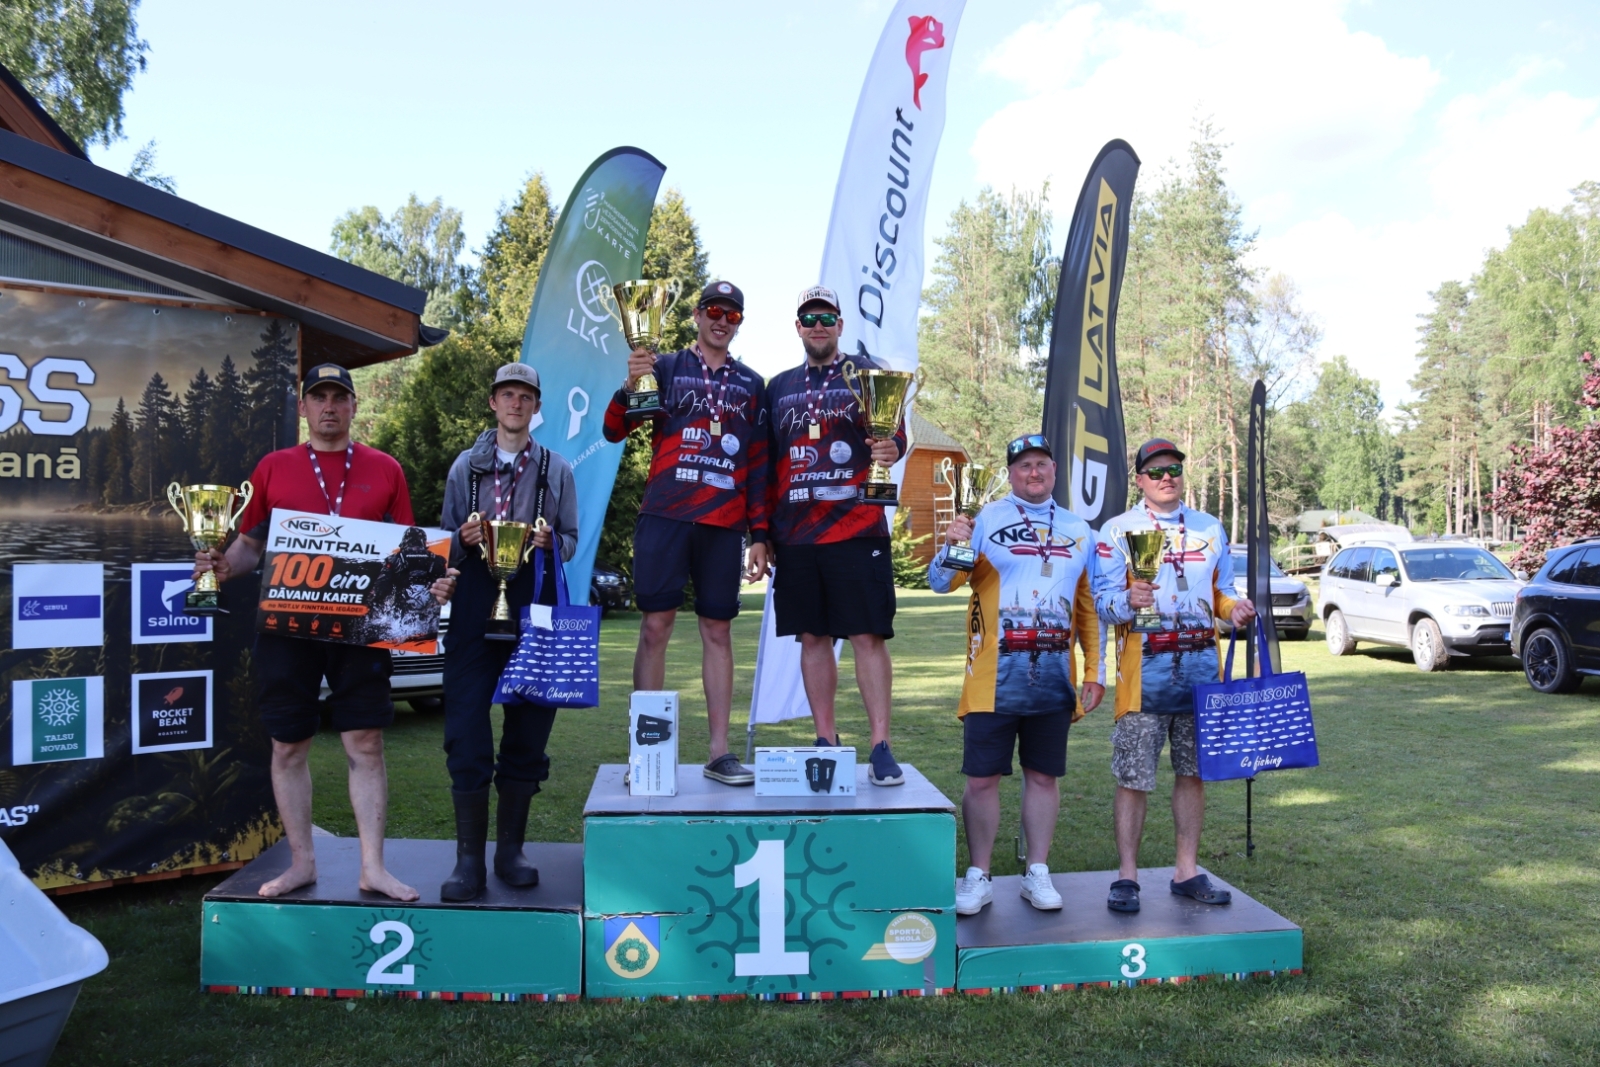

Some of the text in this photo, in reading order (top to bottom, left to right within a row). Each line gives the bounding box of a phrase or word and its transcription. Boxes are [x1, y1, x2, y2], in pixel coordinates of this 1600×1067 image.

[858, 106, 915, 329] Discount
[597, 225, 631, 259] KARTE
[1071, 201, 1114, 522] GT LATVIA
[790, 467, 854, 483] ULTRALINE
[287, 520, 331, 533] NGT.LV
[274, 536, 381, 555] FINNTRAIL
[269, 553, 371, 590] 100 eiro
[268, 586, 363, 604] DĀVANU KARTE
[148, 615, 200, 627] salmo
[525, 684, 543, 697] Vice
[546, 686, 584, 703] Champion
[1222, 684, 1298, 707] ROBINSON
[152, 707, 194, 719] ROCKET
[159, 716, 187, 727] BEAN
[44, 733, 75, 742] TALSU
[40, 743, 79, 753] NOVADS
[786, 756, 797, 765] Fly
[1240, 755, 1283, 771] Go fishing
[734, 839, 810, 977] 1
[889, 928, 921, 936] SPORTA
[365, 920, 415, 985] 2
[1120, 943, 1147, 978] 3
